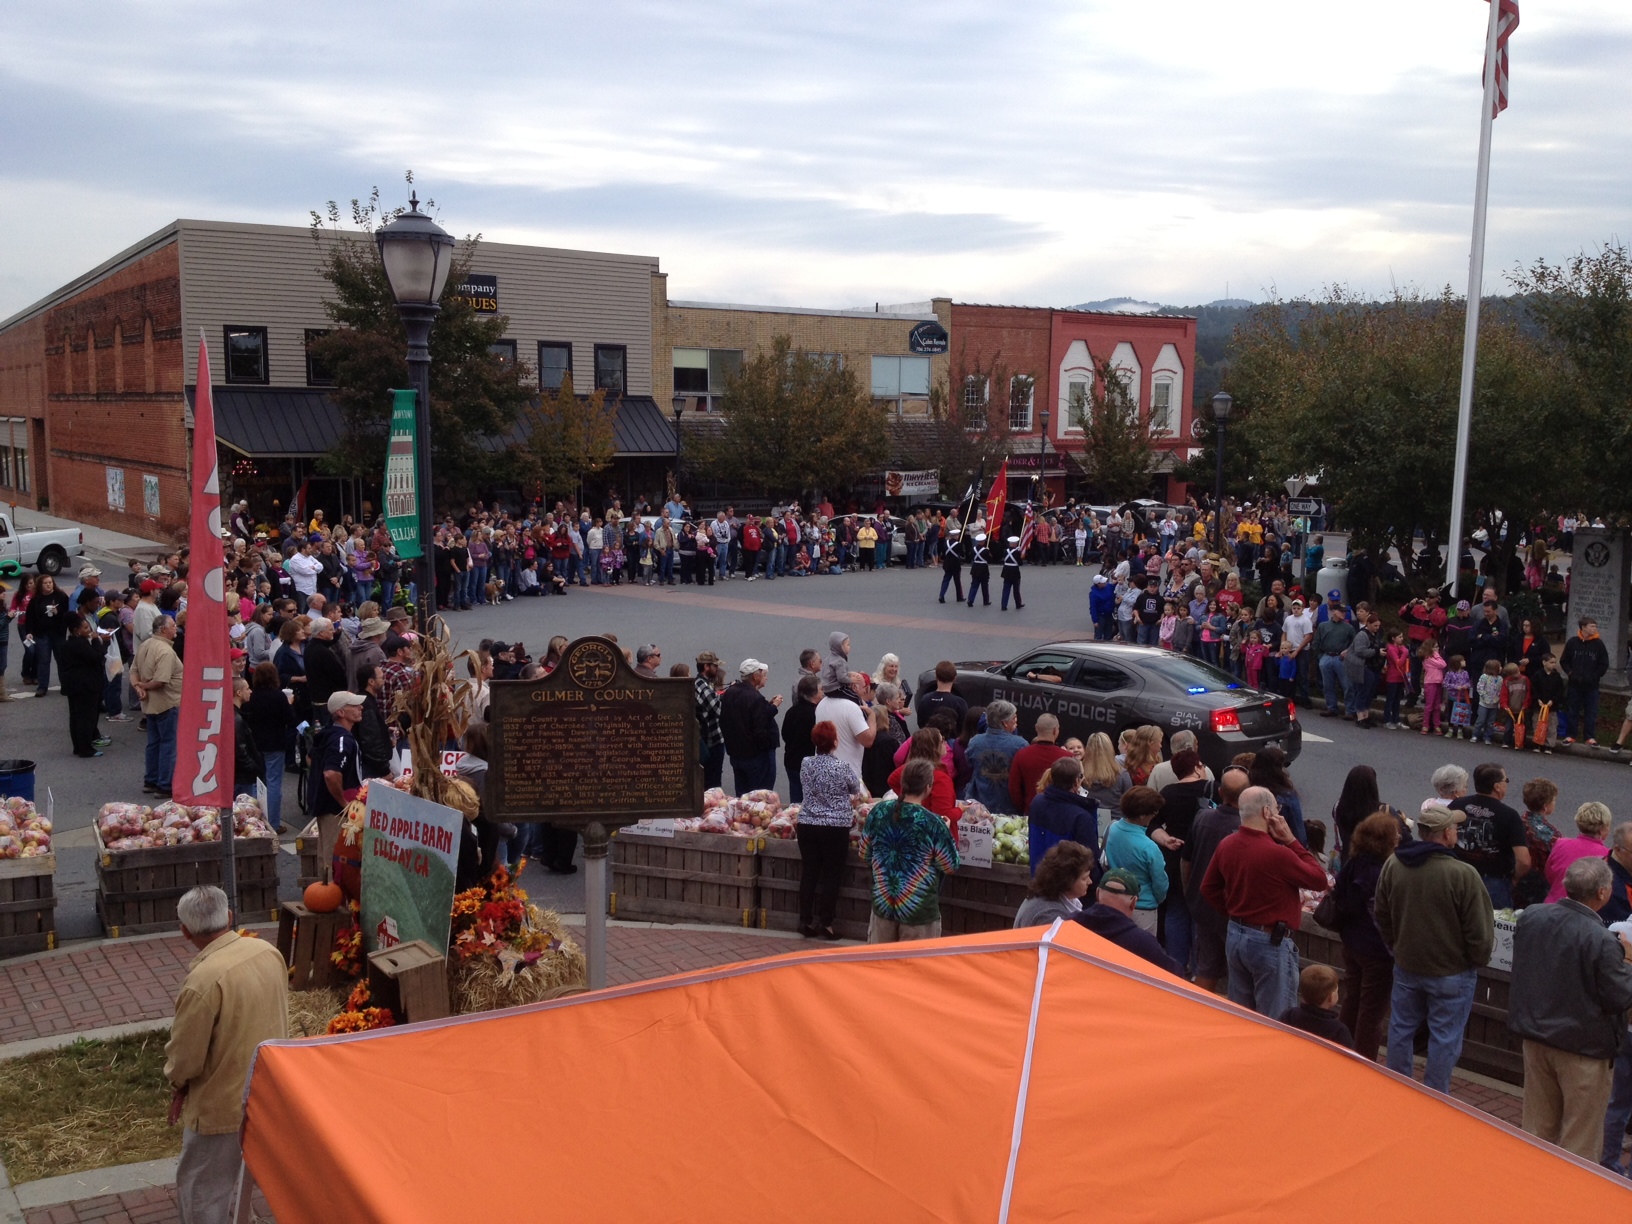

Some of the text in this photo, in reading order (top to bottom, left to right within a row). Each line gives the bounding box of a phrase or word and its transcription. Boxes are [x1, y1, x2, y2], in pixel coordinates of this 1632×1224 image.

[455, 284, 496, 296] ompany
[1146, 598, 1156, 611] G
[572, 644, 612, 663] GEORGIA
[531, 689, 655, 701] GILMER COUNTY
[1058, 700, 1117, 724] POLICE
[1176, 711, 1199, 720] DIAL
[1170, 718, 1203, 730] 9-1-1
[370, 809, 453, 854] RED APPLE BARN
[970, 826, 991, 835] Black
[414, 854, 429, 878] GA
